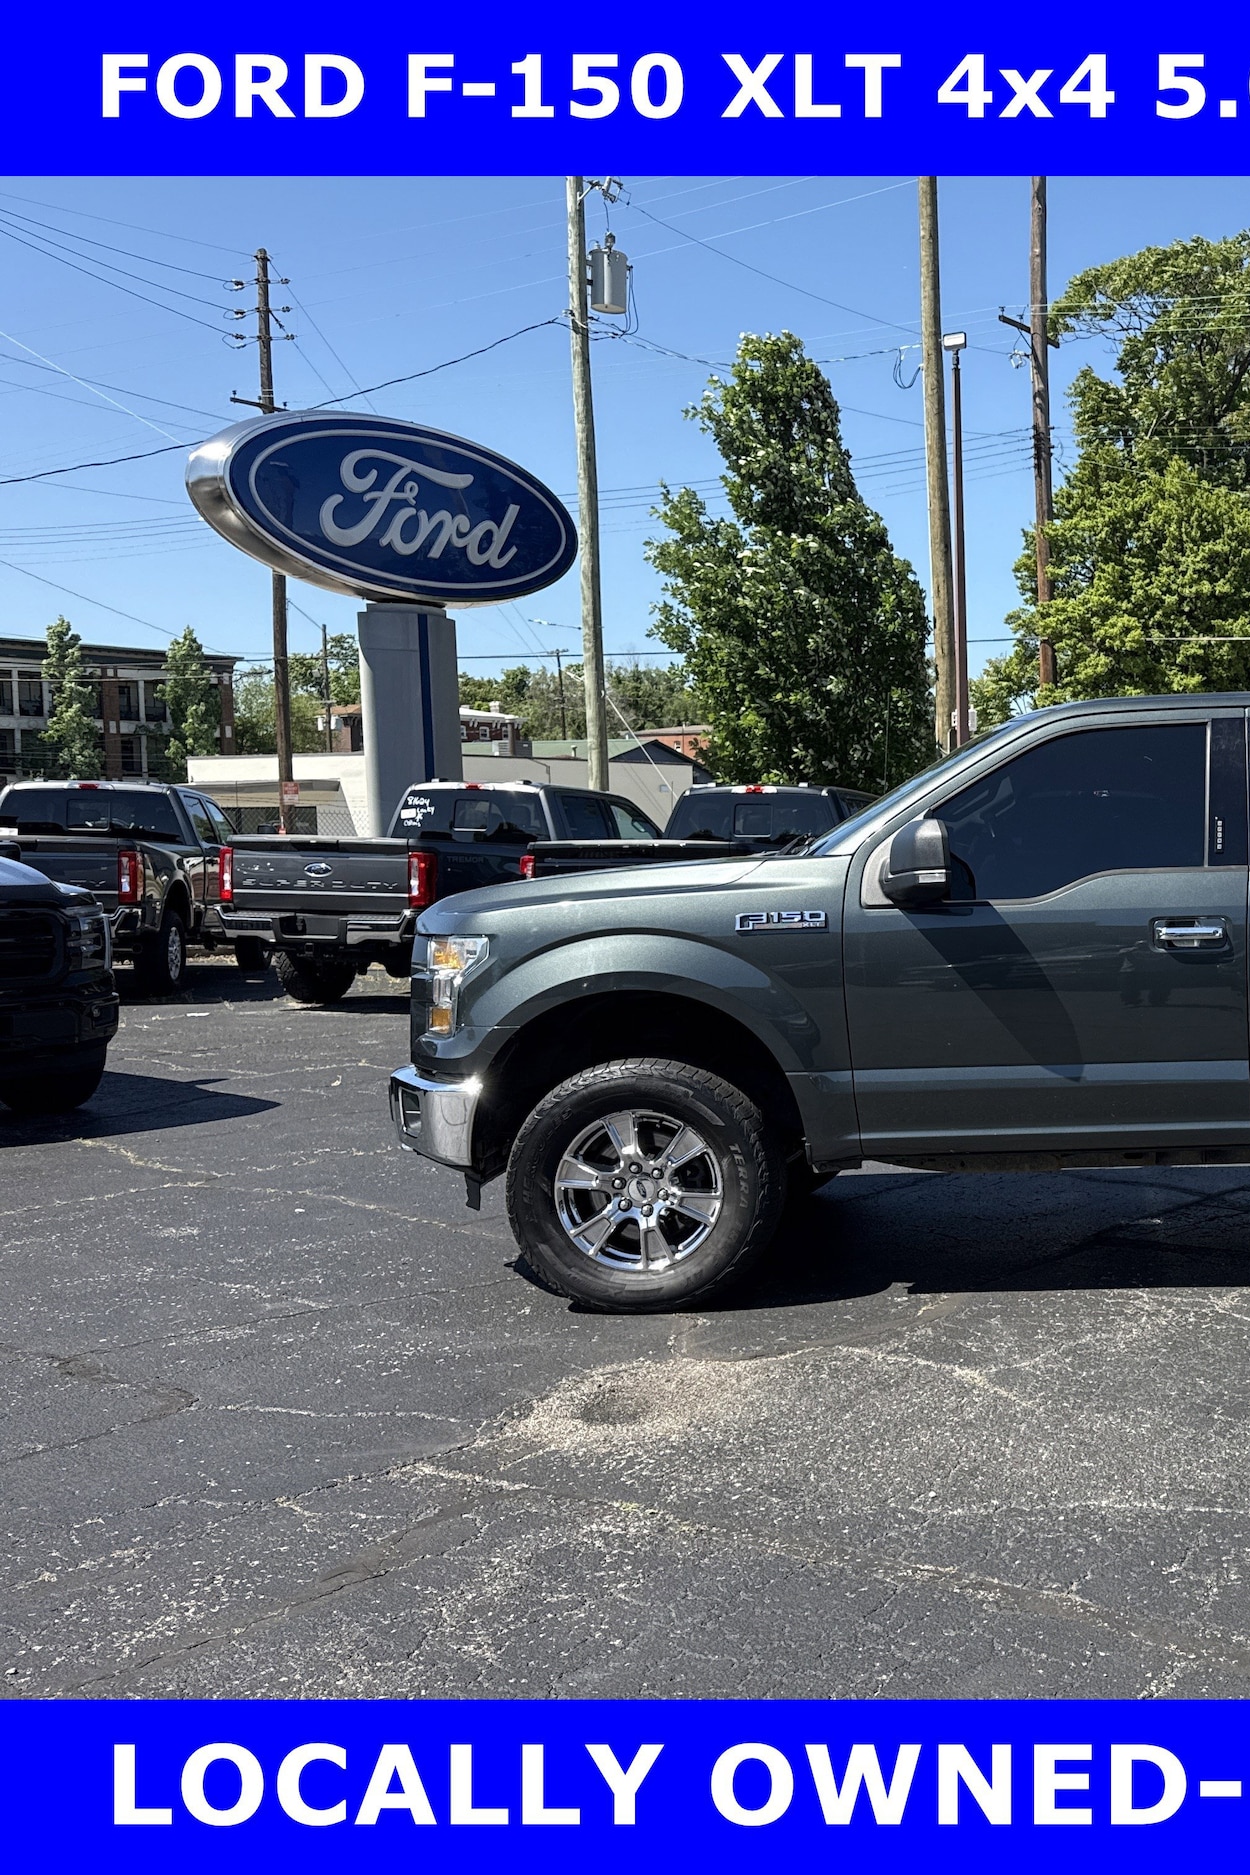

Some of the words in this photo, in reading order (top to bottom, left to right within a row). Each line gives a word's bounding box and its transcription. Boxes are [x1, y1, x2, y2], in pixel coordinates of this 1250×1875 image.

[319, 448, 520, 569] Ford
[446, 855, 486, 864] TREMOR
[242, 878, 325, 888] SUPER
[332, 880, 398, 890] DUTY
[728, 1143, 750, 1209] TERRA
